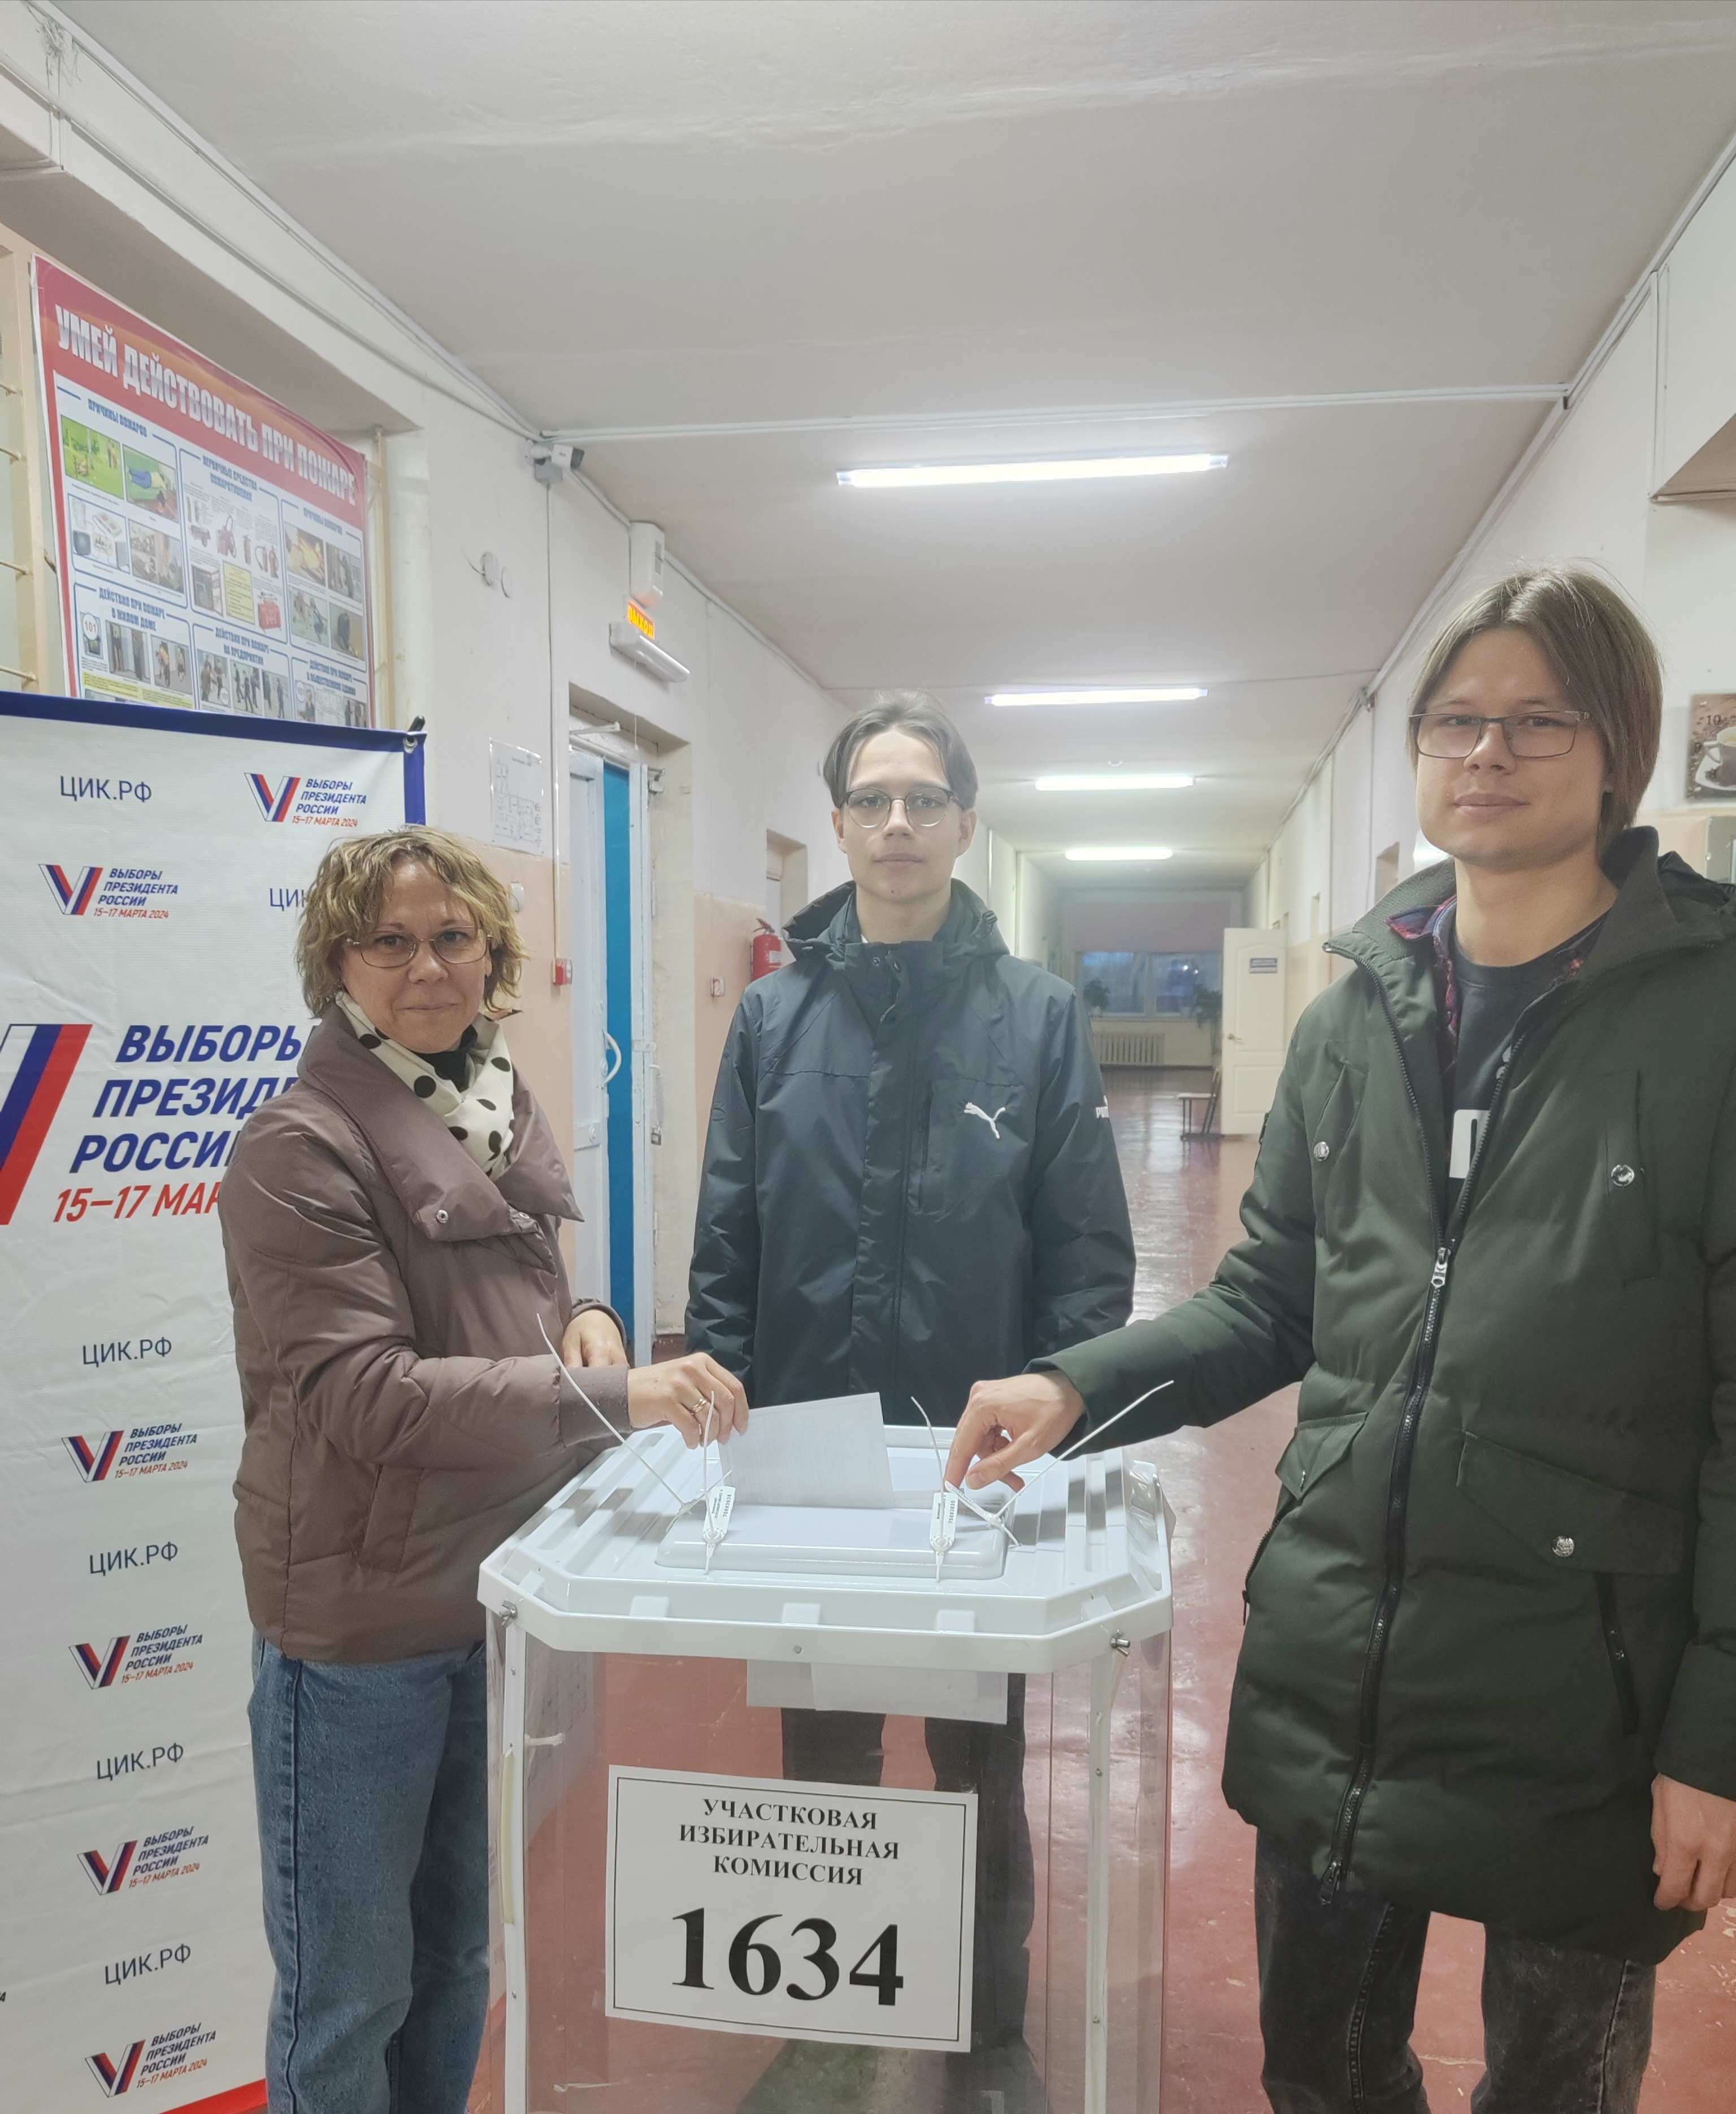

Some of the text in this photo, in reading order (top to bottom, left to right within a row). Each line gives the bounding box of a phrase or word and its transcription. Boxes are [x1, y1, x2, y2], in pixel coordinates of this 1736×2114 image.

[55, 304, 355, 505] УМЕЙ ДЕЙСТВОВАТЬ ПРИ ПОЖАРЕ
[131, 598, 142, 611] ПРИ
[60, 776, 152, 802] ЦИК.РФ
[306, 779, 353, 791] ВЫБОРЫ
[301, 791, 367, 804] ПРЕЗИДЕНТА
[296, 804, 339, 815] РОССИИ
[314, 817, 339, 826] МАРТА
[341, 819, 358, 827] 2024
[110, 869, 163, 880] ВЫБОРЫ
[104, 882, 178, 895] ПРЕЗИДЕНТА
[98, 895, 147, 906] РОССИИ
[119, 909, 147, 918] МАРТА
[149, 910, 170, 919] 2024
[92, 1078, 299, 1119] ПРЕЗИД
[69, 1131, 240, 1173] РОССИ
[83, 1337, 172, 1368] ЦИК.РФ
[131, 1423, 182, 1439] ВЫБОРЫ
[124, 1434, 197, 1452] ПРЕЗИДЕНТА
[119, 1451, 166, 1466] РОССИИ
[139, 1464, 167, 1475] МАРТА
[168, 1460, 188, 1471] 2024
[90, 1541, 178, 1576] ЦИК.РФ
[136, 1624, 188, 1643] ВЫБОРЫ
[131, 1634, 203, 1657] ПРЕЗИДЕНТА
[125, 1653, 172, 1672] РОССИИ
[145, 1666, 172, 1679] МАРТА
[174, 1661, 193, 1673] 2024
[97, 1743, 184, 1781] ЦИК.РФ
[702, 1798, 878, 1830] УЧАСТКОВАЯ
[144, 1826, 194, 1847] ВЫБОРЫ
[679, 1824, 900, 1860] ИЗБИРАТЕЛЬНАЯ
[138, 1834, 209, 1862] ПРЕЗИДЕНТА
[133, 1855, 179, 1876] РОССИИ
[152, 1867, 179, 1882] МАРТА
[181, 1862, 200, 1875] 2024
[713, 1855, 862, 1885] КОМИССИЯ
[105, 1943, 190, 1985] ЦИК.РФ
[672, 1907, 904, 2006] 1634
[151, 2022, 201, 2047] ВЫБОРЫ
[146, 2030, 216, 2061] ПРЕЗИДЕНТА
[141, 2054, 186, 2076] РОССИИ
[160, 2065, 187, 2082] МАРТА
[189, 2058, 207, 2073] 2024
